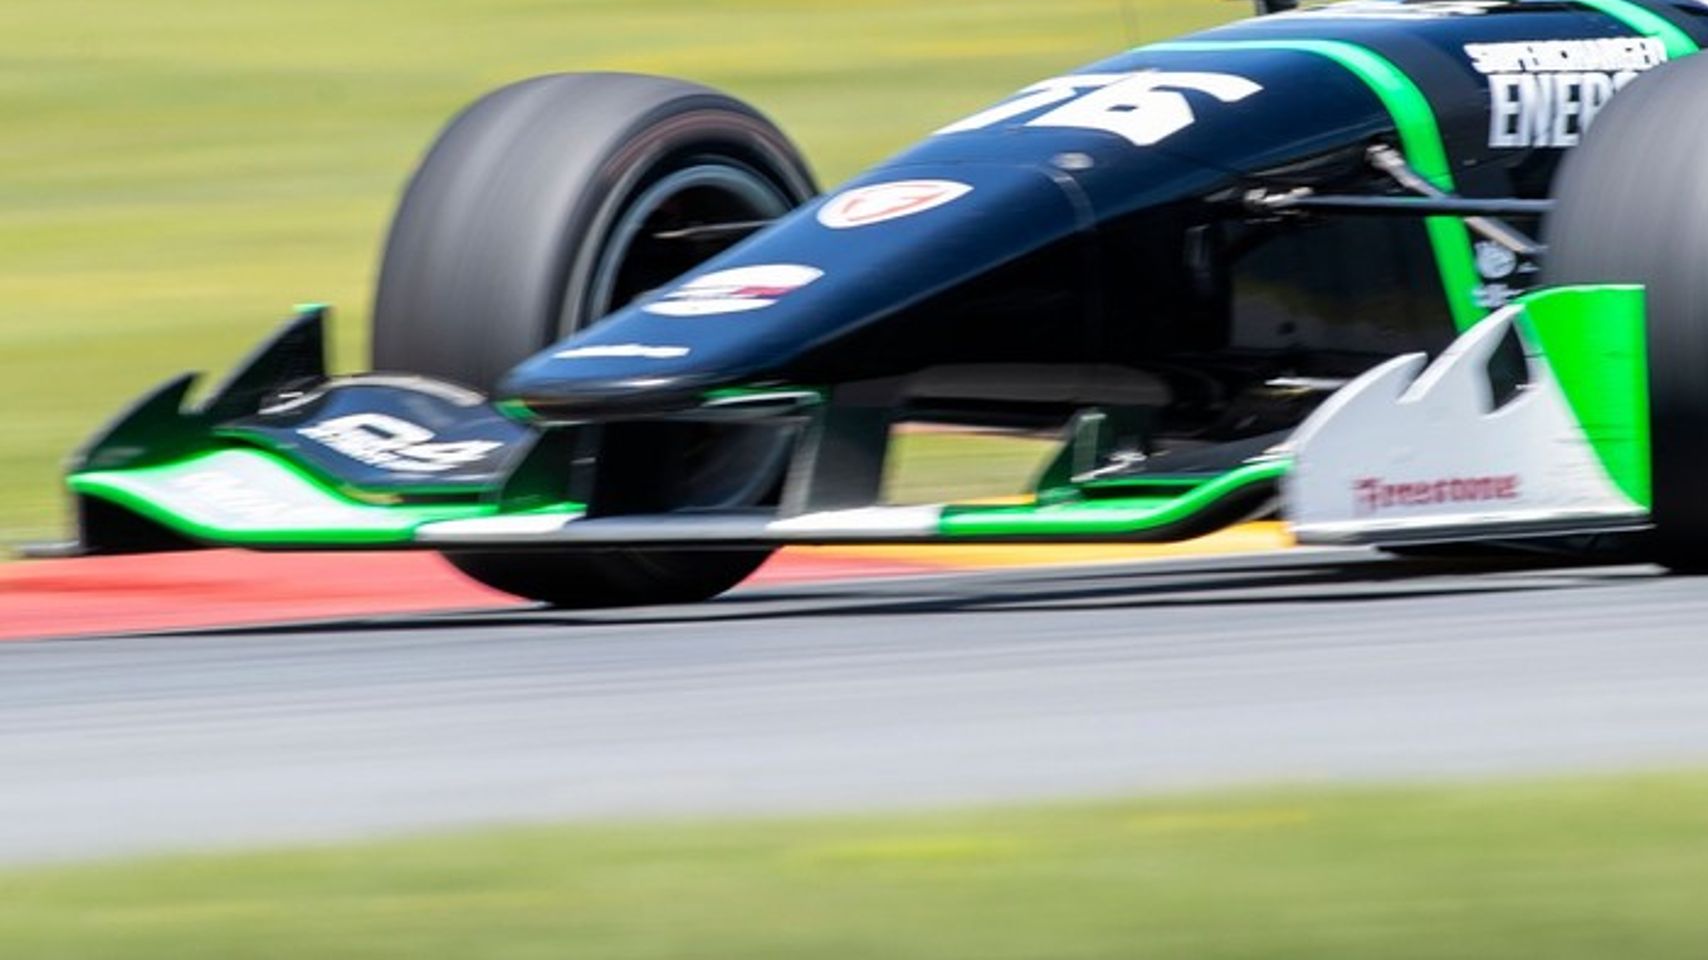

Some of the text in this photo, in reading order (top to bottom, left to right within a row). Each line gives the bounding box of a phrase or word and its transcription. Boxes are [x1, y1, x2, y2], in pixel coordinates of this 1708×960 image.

[930, 70, 1265, 146] 76
[1487, 71, 1640, 148] ENER
[1353, 476, 1520, 512] Firestone
